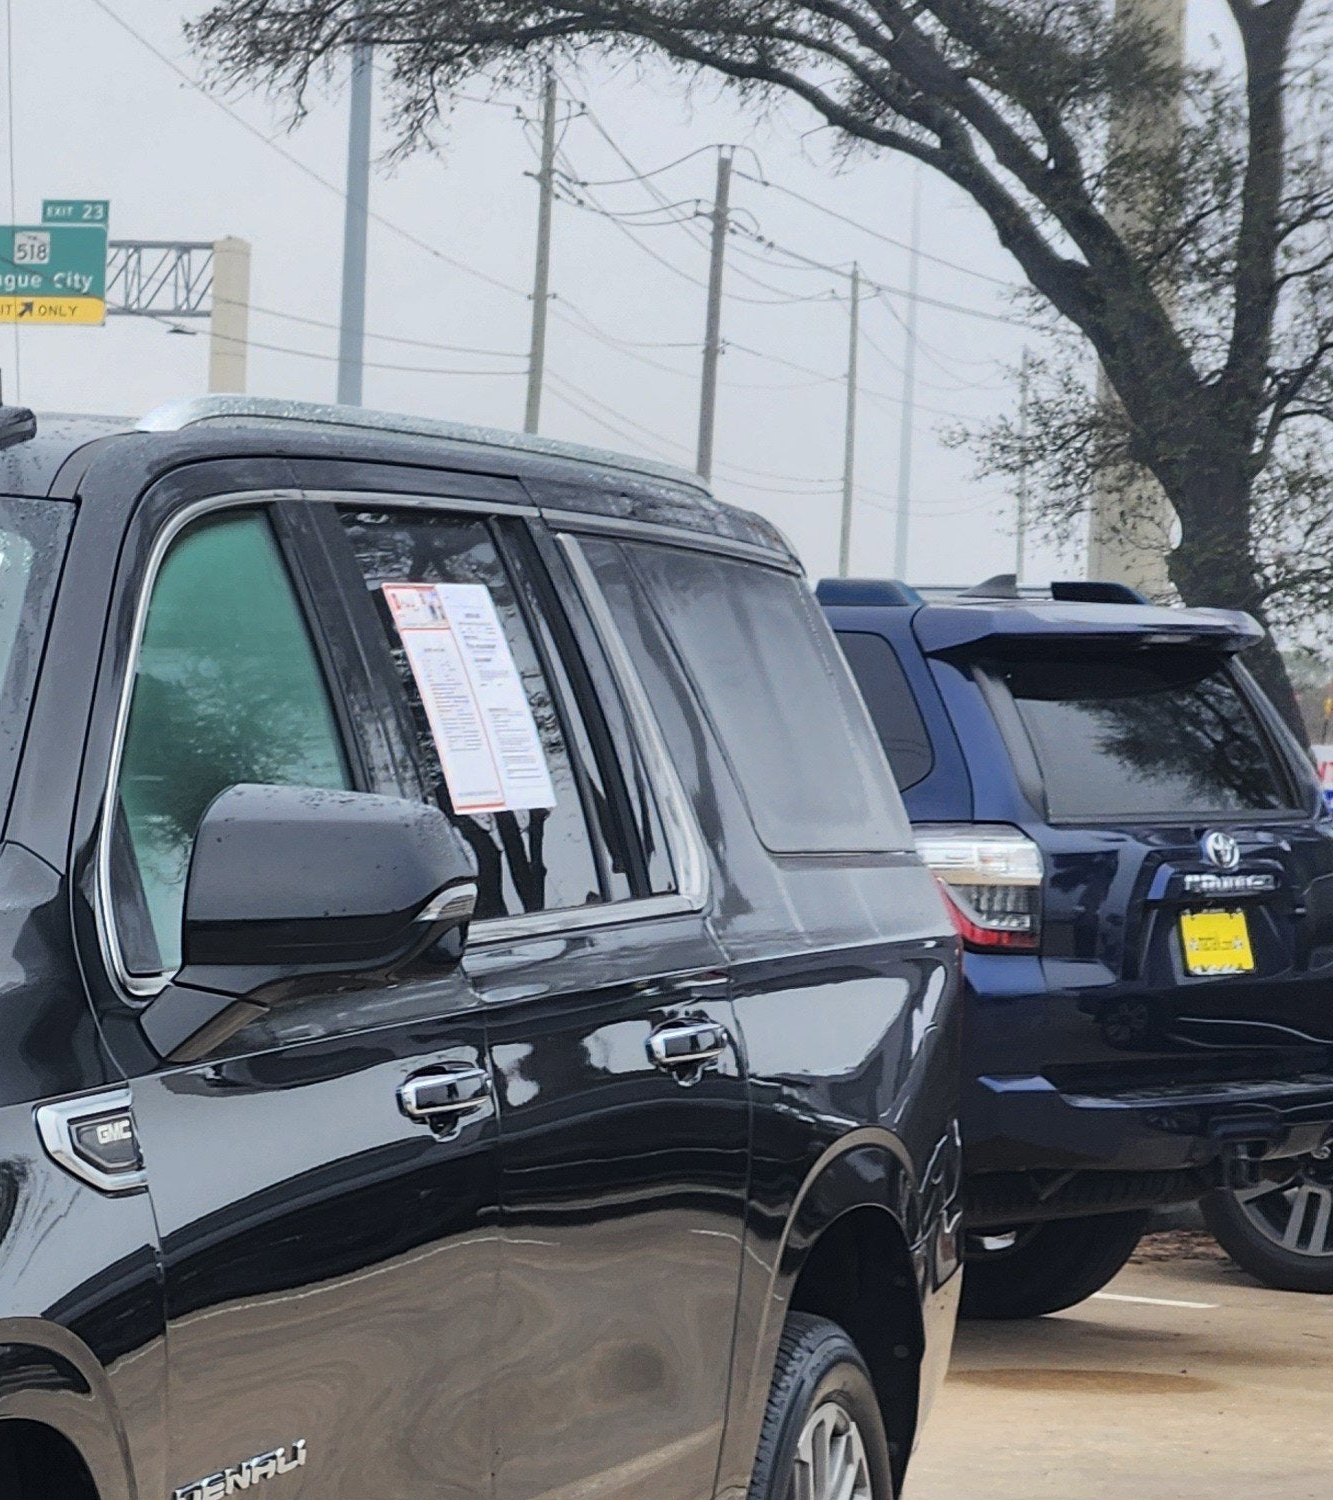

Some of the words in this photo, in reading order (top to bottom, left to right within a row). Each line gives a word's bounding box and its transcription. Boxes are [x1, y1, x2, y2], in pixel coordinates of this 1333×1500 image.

[46, 205, 74, 217] EXIT
[82, 204, 104, 220] 23
[16, 244, 48, 261] 518
[53, 270, 94, 293] City
[38, 304, 79, 317] ONLY
[96, 1119, 132, 1145] GMC
